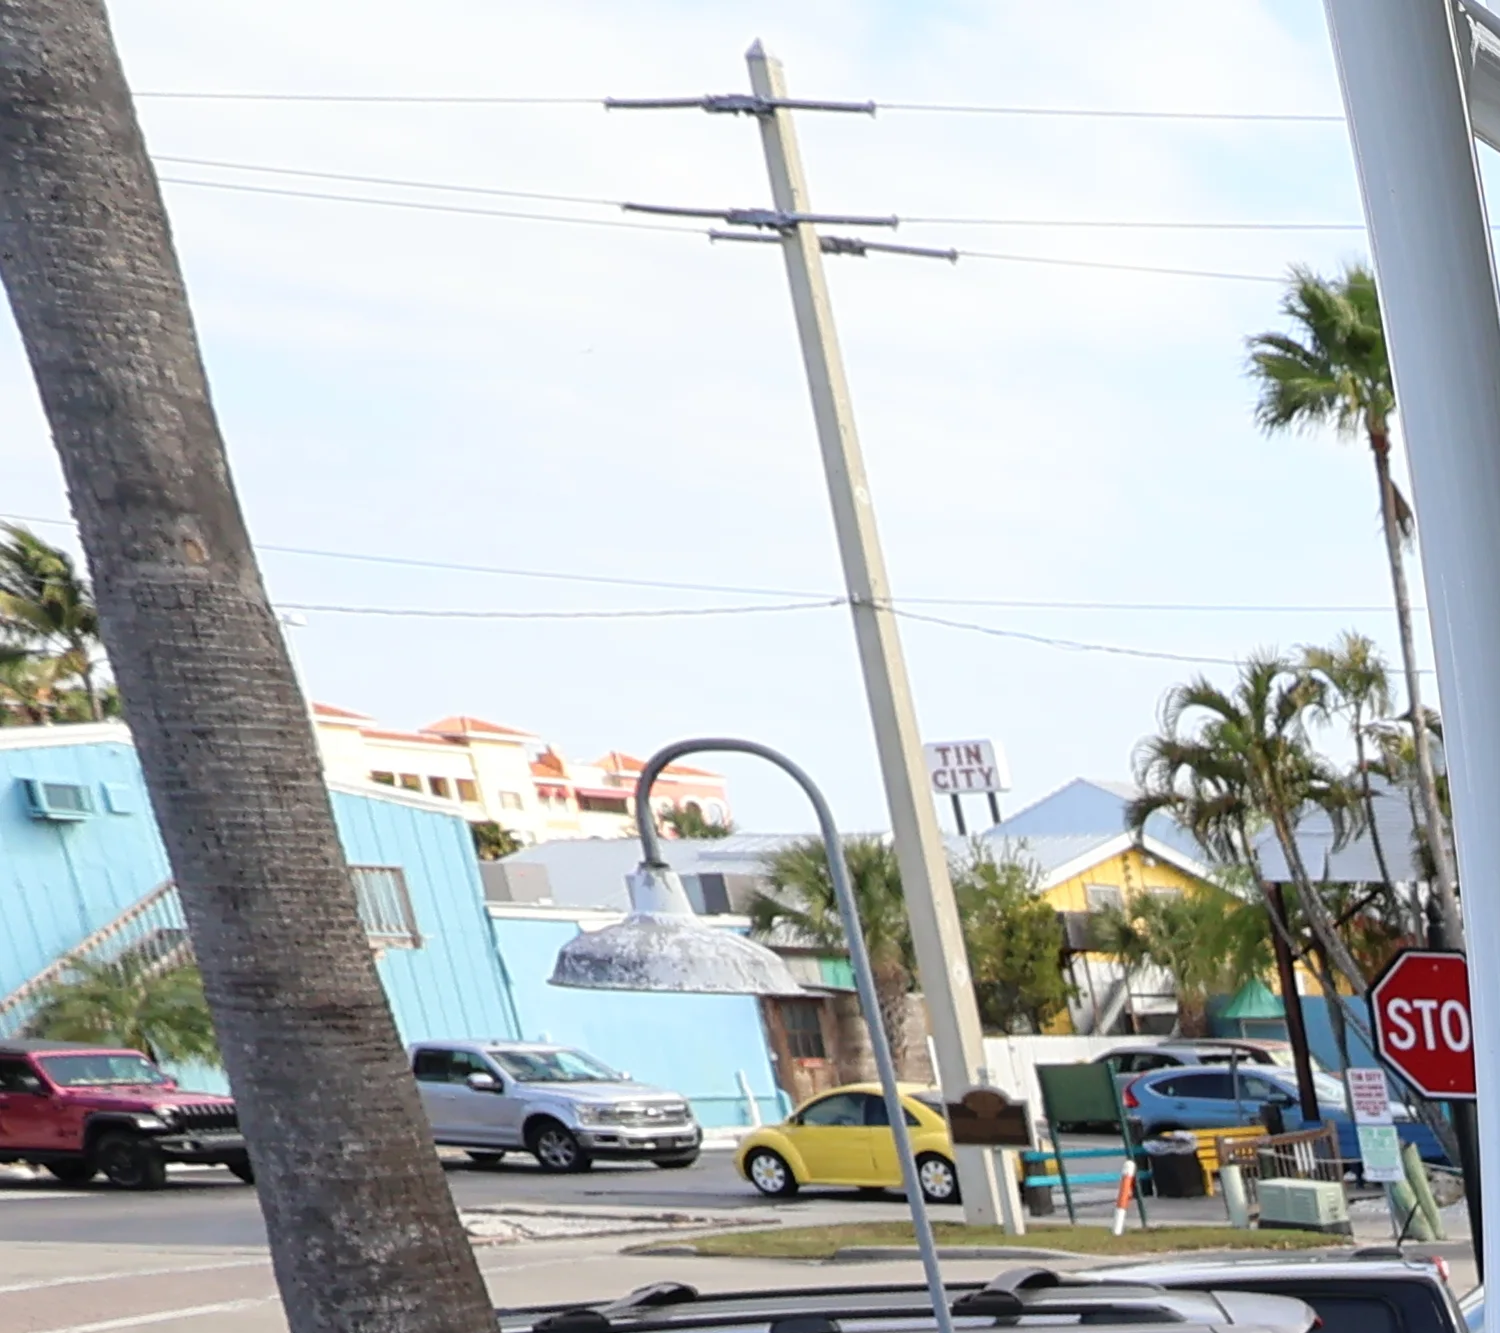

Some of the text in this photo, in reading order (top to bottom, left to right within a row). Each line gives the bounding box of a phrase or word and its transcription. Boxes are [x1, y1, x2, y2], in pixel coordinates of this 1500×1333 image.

[934, 744, 983, 767] TIN
[932, 766, 993, 789] CITY
[1387, 998, 1471, 1052] STO
